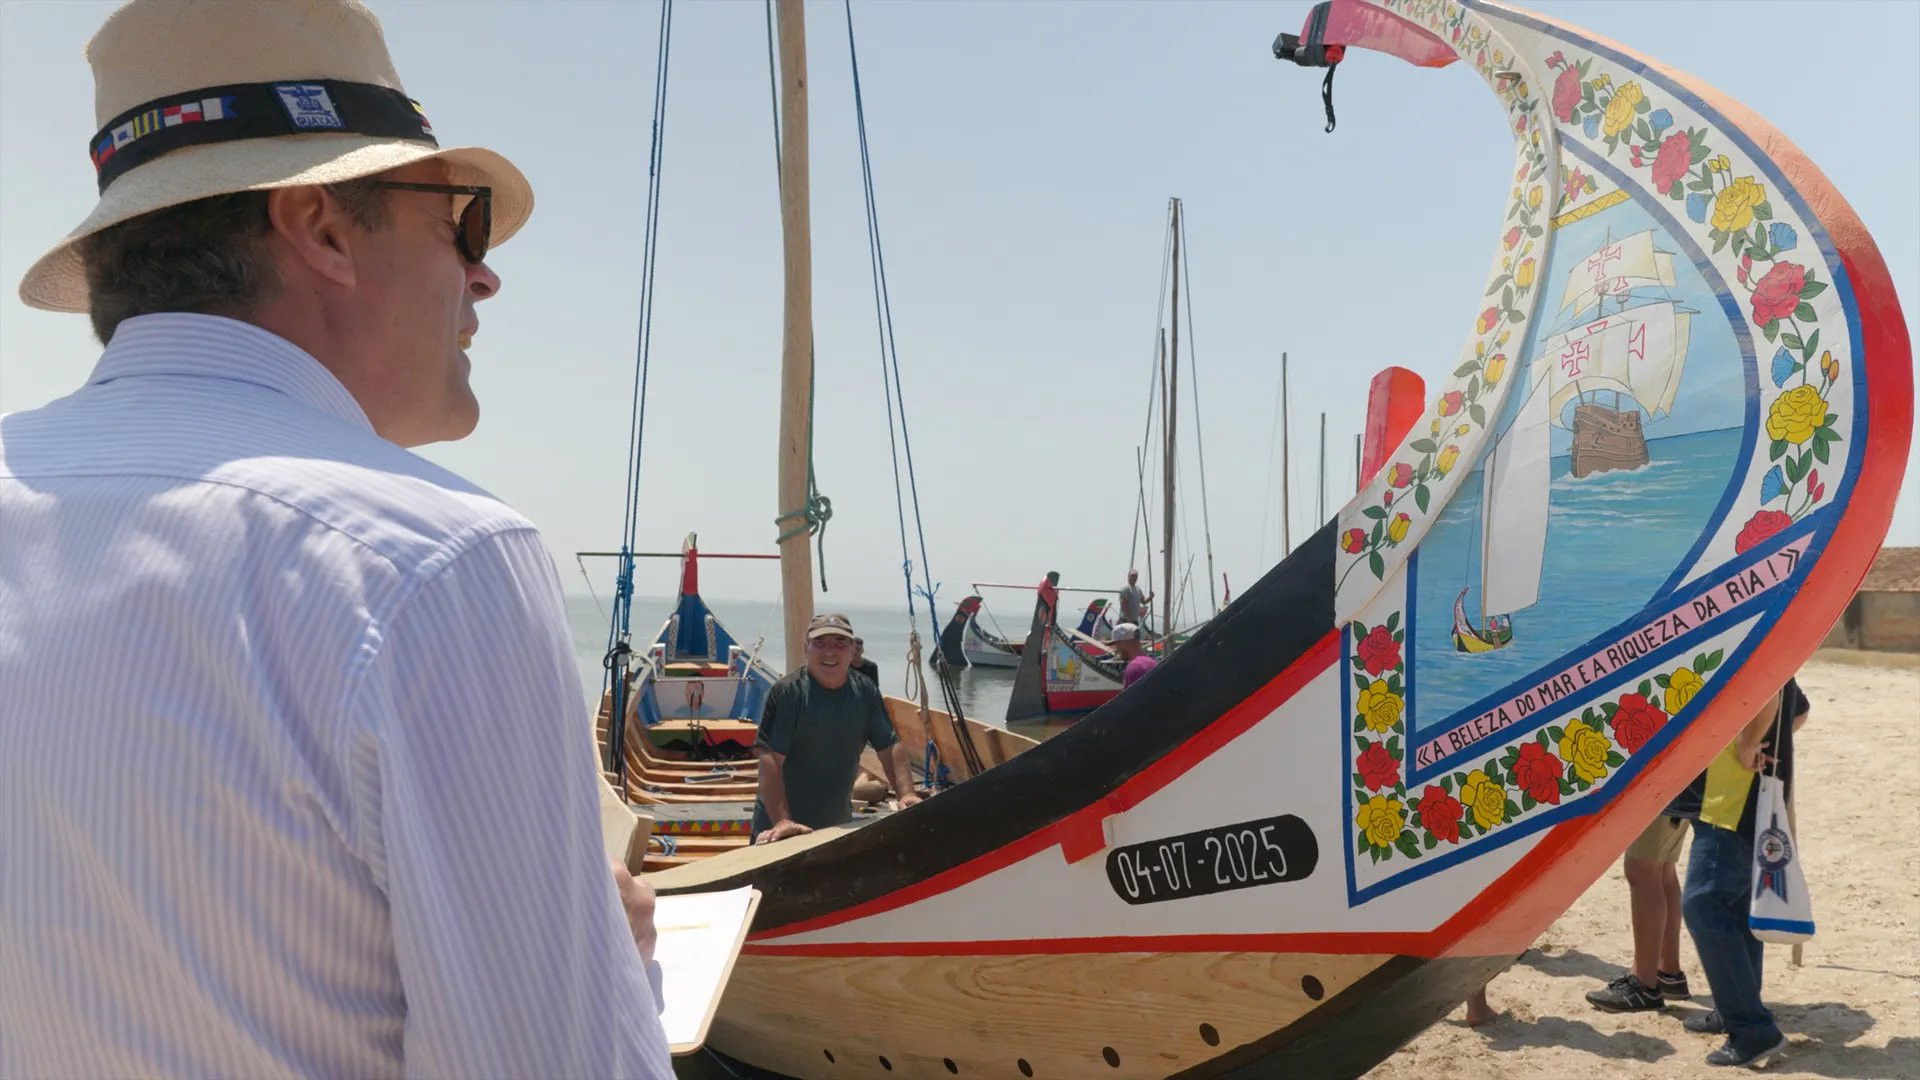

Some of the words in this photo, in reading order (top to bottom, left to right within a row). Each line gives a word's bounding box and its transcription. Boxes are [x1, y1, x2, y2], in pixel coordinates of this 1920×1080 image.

[1448, 707, 1512, 752] BELEZA
[1516, 694, 1536, 717] DO
[1537, 673, 1577, 706] MAR
[1578, 664, 1591, 685] E
[1593, 658, 1607, 679] A
[1607, 613, 1690, 669] RIQUEZA
[1693, 595, 1721, 622] DA
